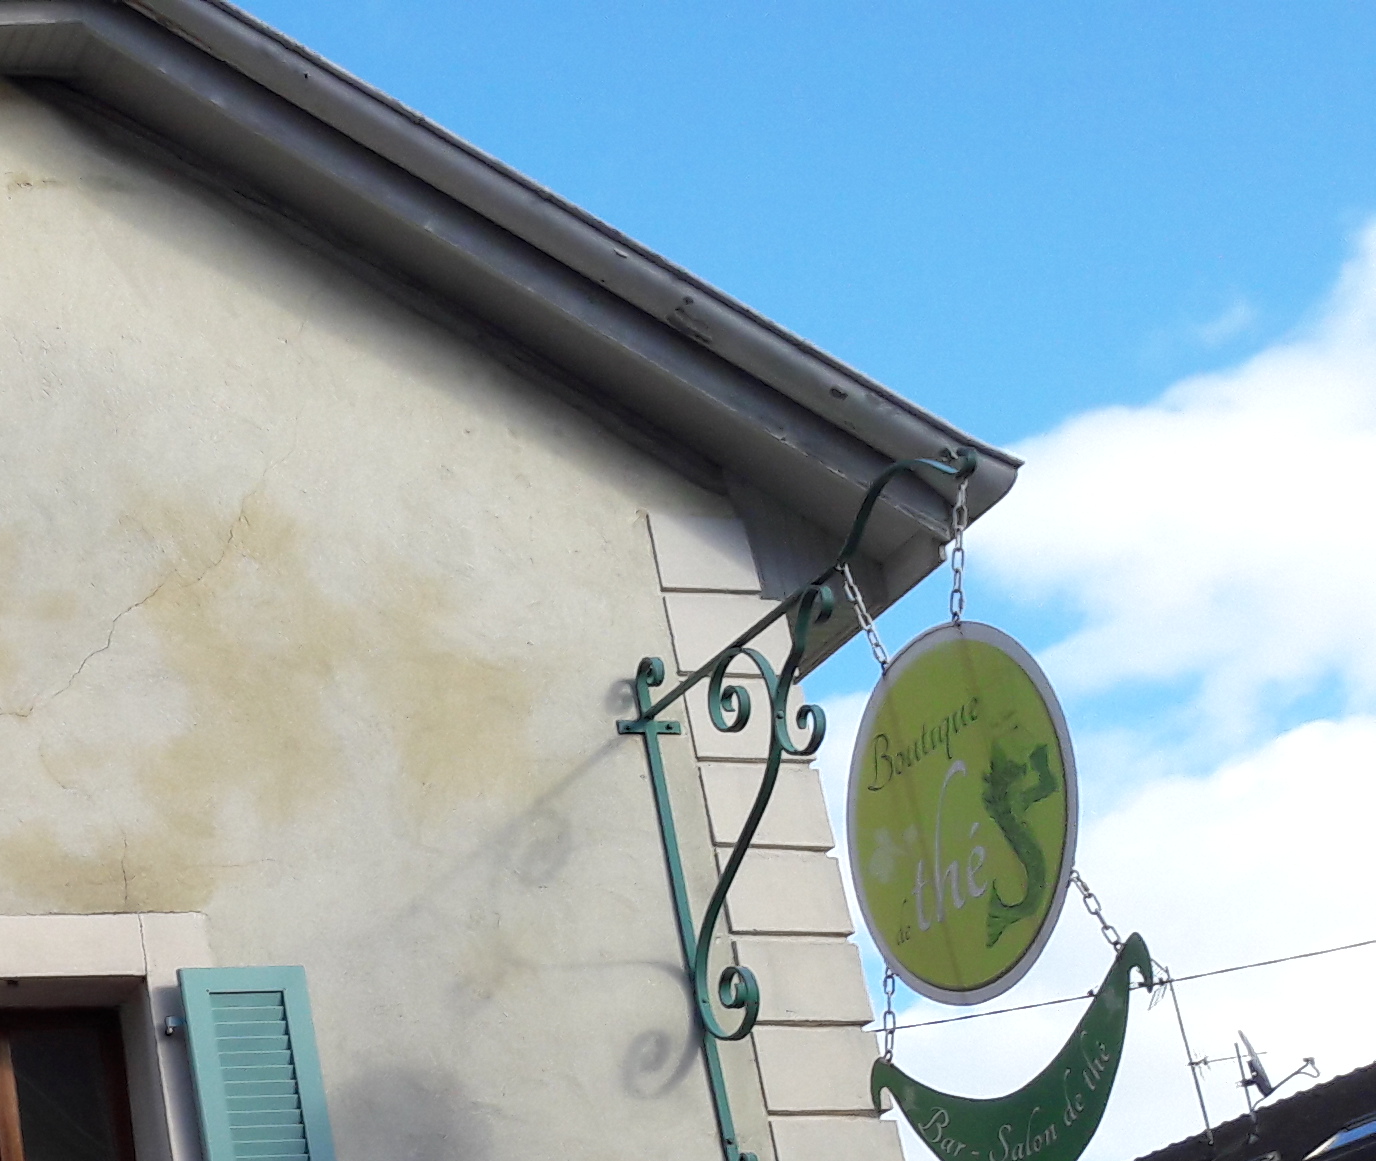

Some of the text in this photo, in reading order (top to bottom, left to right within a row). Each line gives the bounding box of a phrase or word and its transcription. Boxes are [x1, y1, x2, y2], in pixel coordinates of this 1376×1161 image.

[867, 696, 979, 792] Boutique
[912, 759, 988, 932] thé
[917, 1106, 967, 1158] Bar
[1063, 1067, 1085, 1127] de
[1079, 1029, 1111, 1091] thé
